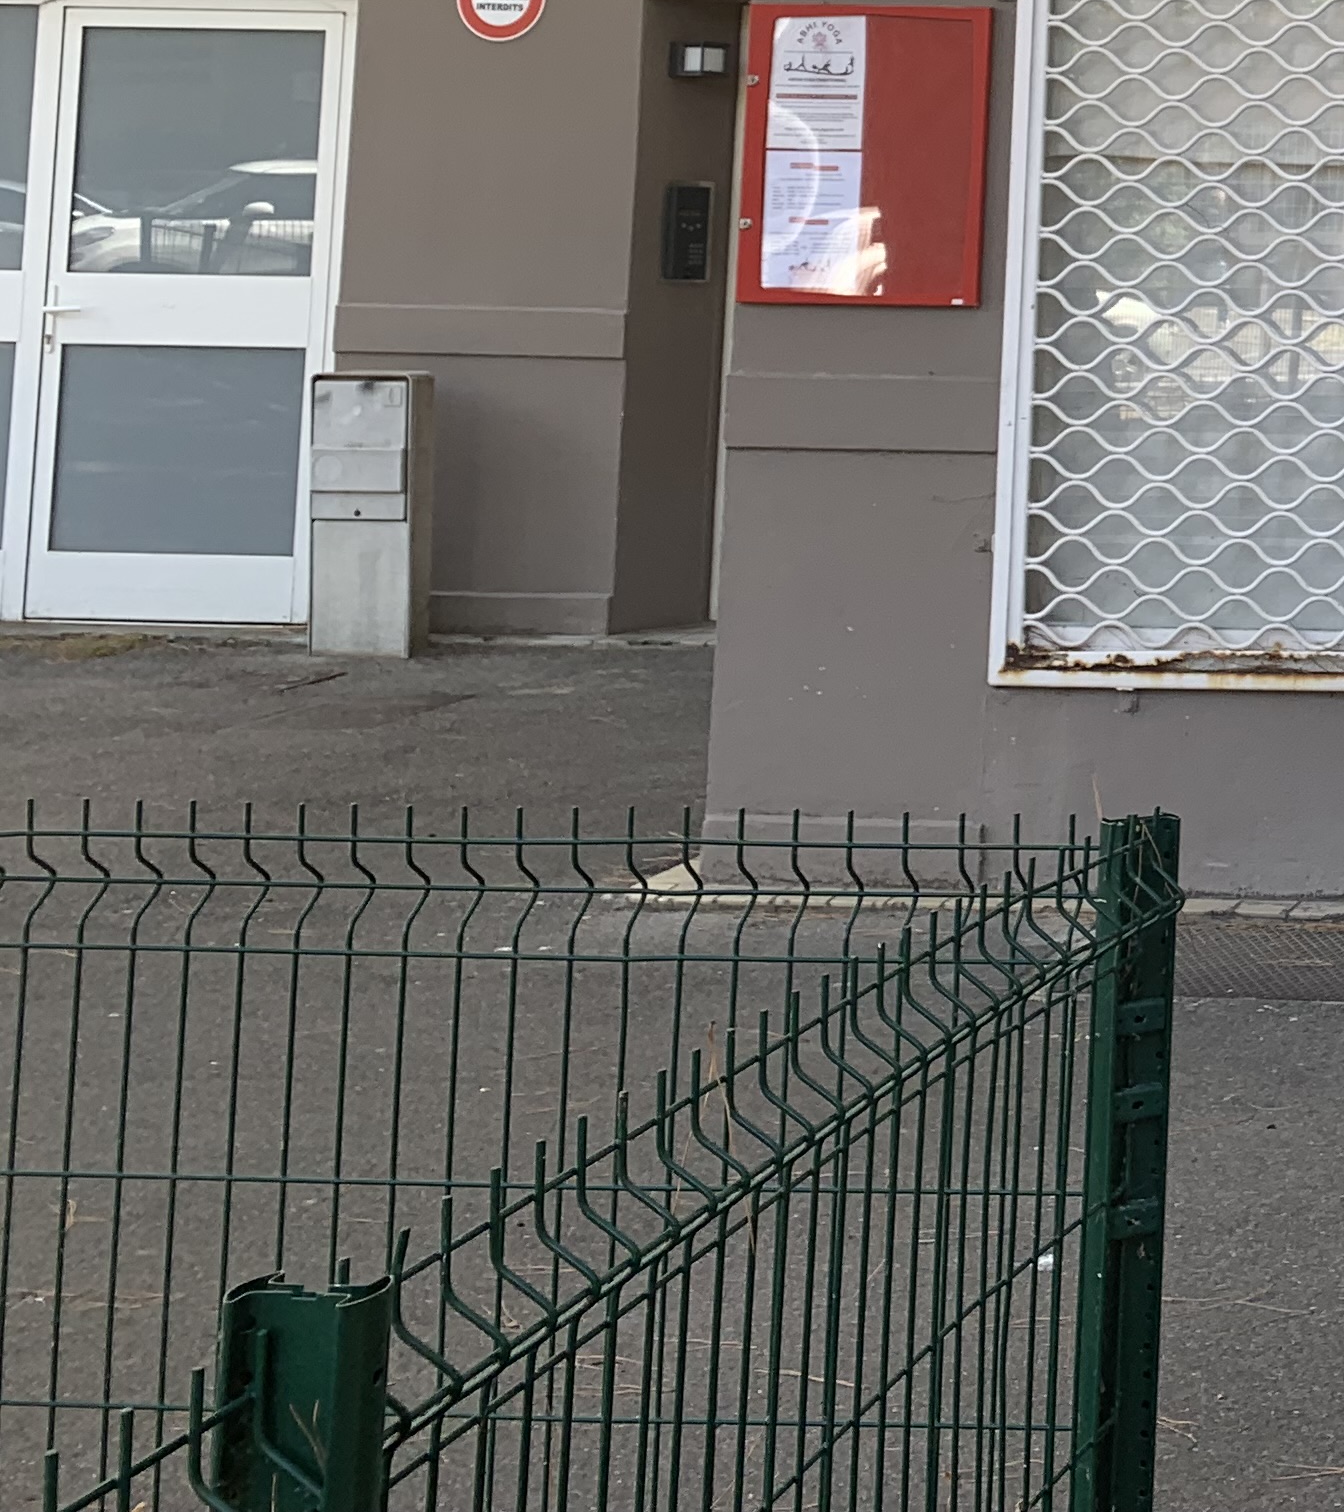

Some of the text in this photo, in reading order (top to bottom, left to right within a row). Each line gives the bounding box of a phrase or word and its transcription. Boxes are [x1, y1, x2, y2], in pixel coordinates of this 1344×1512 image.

[476, 3, 523, 11] INTERDITS
[796, 21, 843, 45] ABHI YOGA
